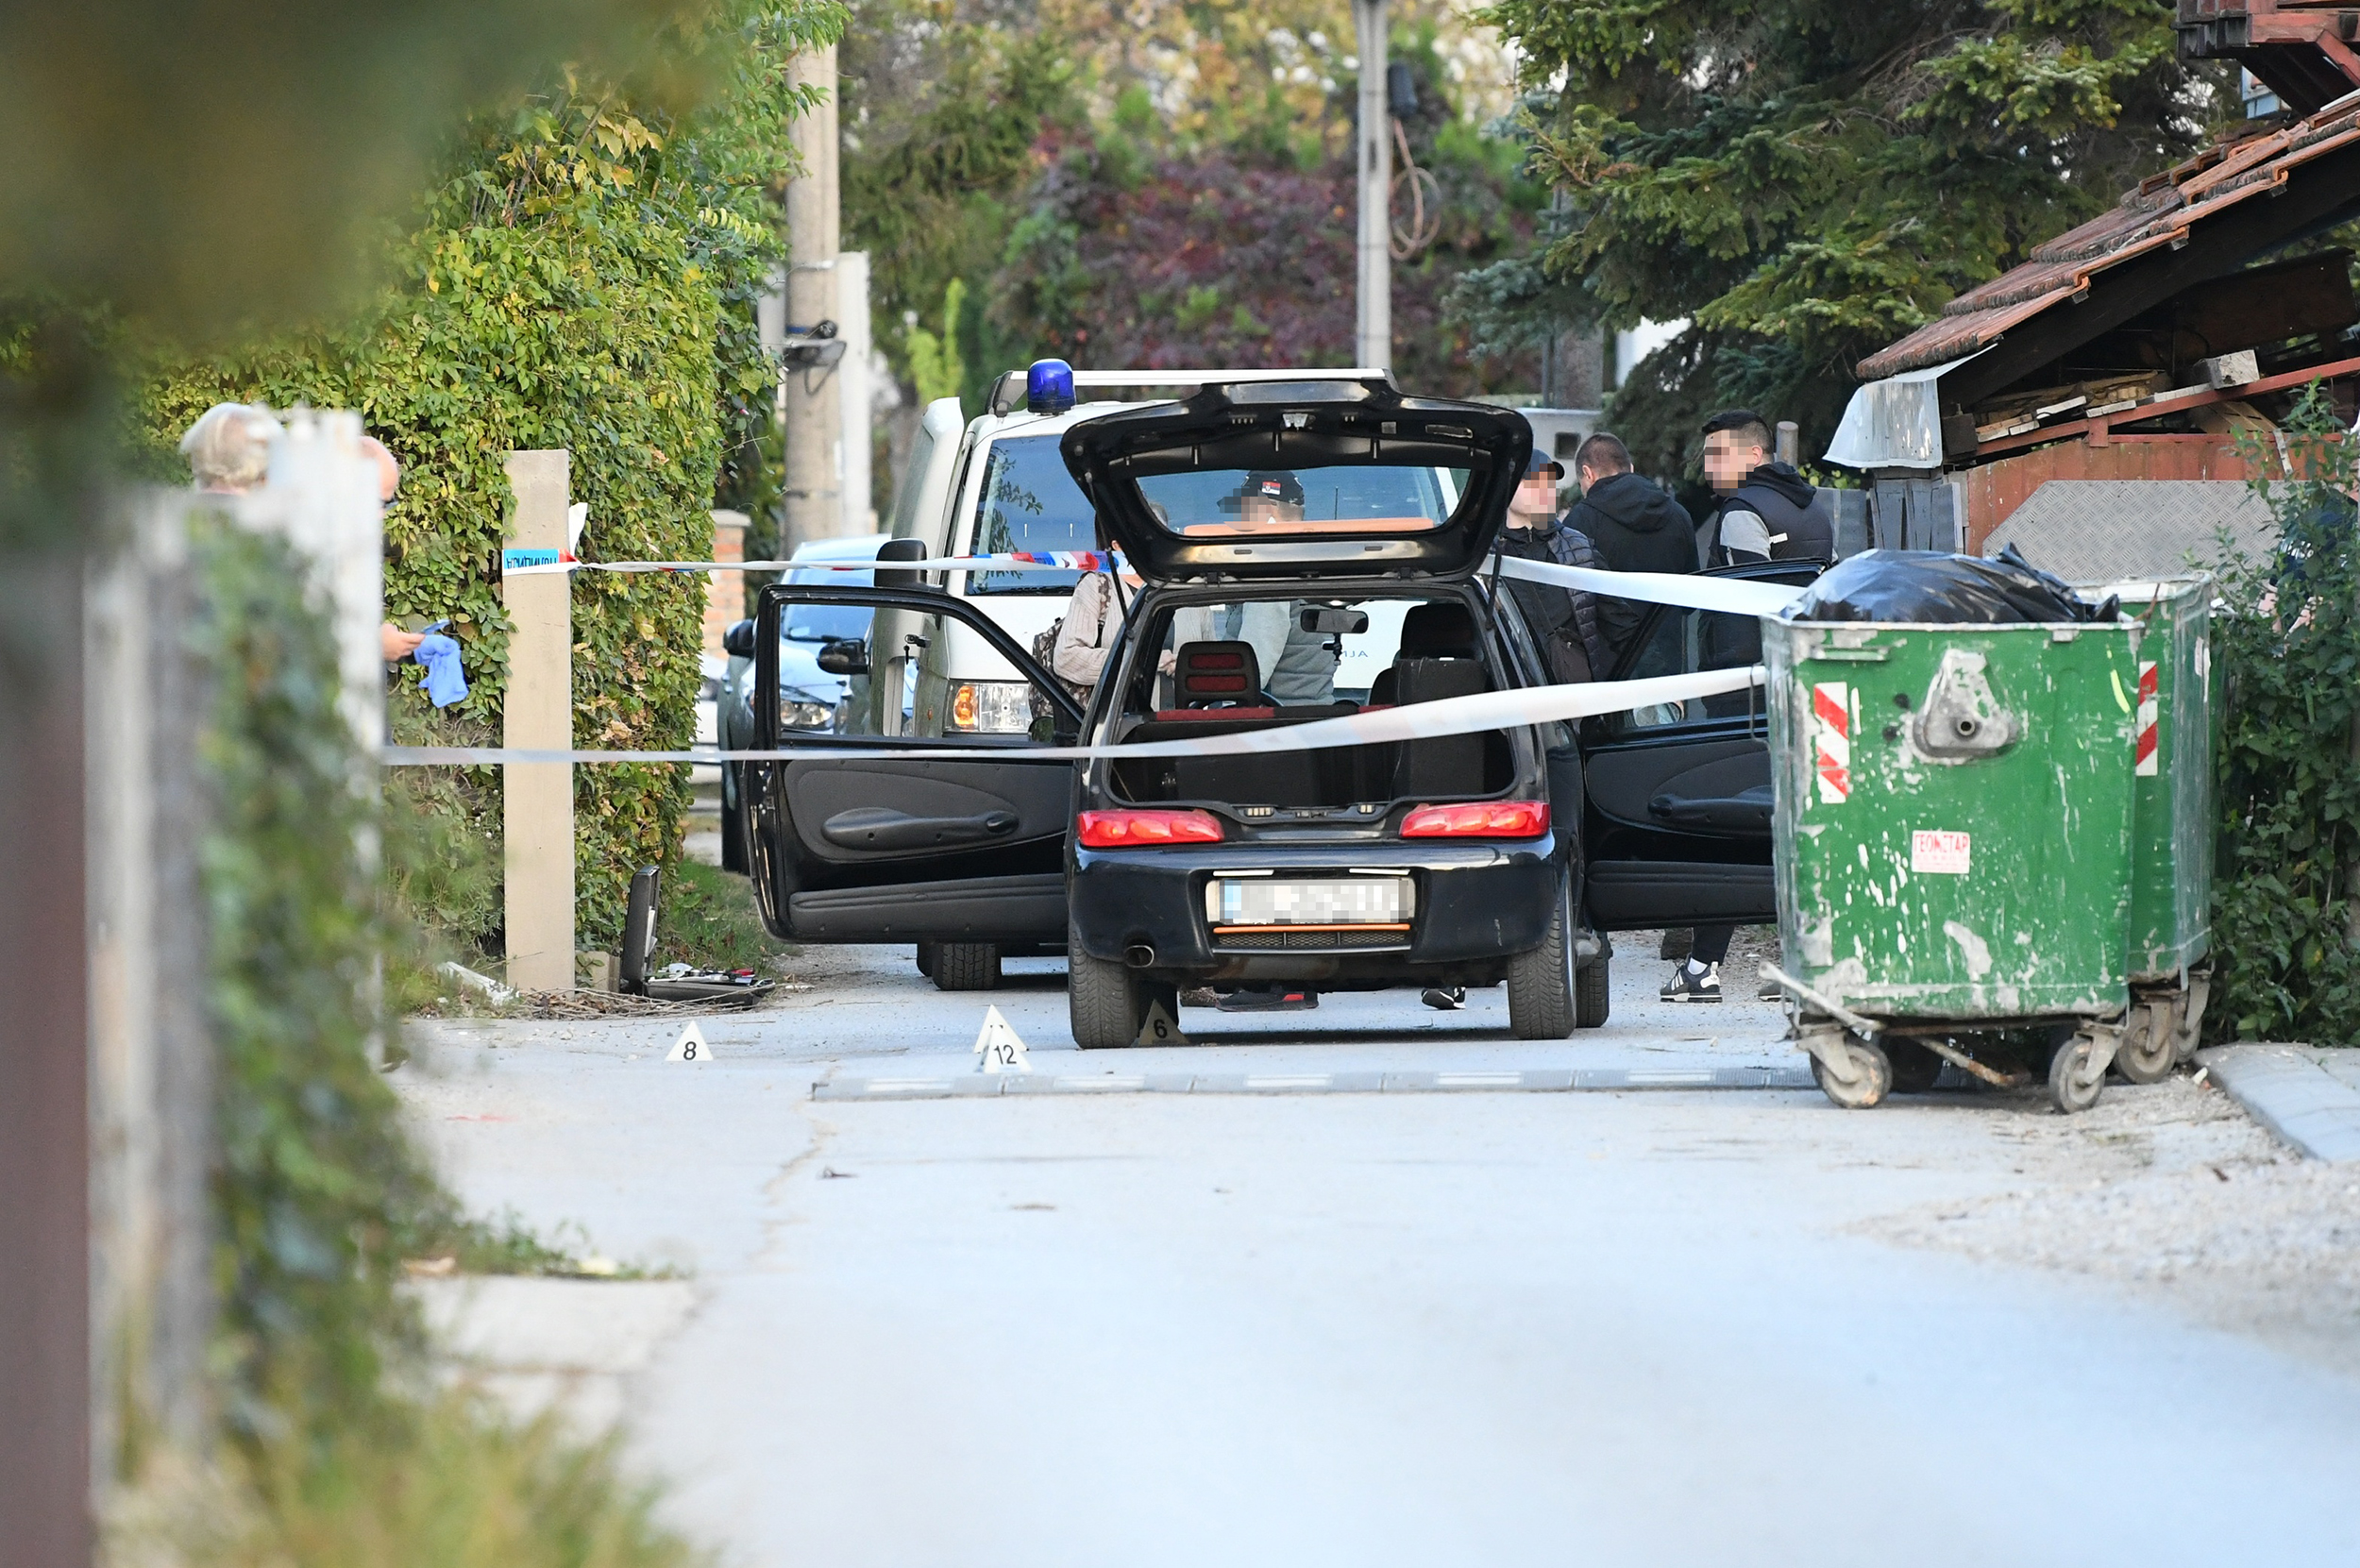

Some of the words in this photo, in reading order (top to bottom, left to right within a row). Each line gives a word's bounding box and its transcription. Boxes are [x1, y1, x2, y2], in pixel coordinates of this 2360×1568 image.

[1154, 1019, 1168, 1039] 6
[683, 1040, 697, 1061] 8
[993, 1044, 1017, 1065] 12
